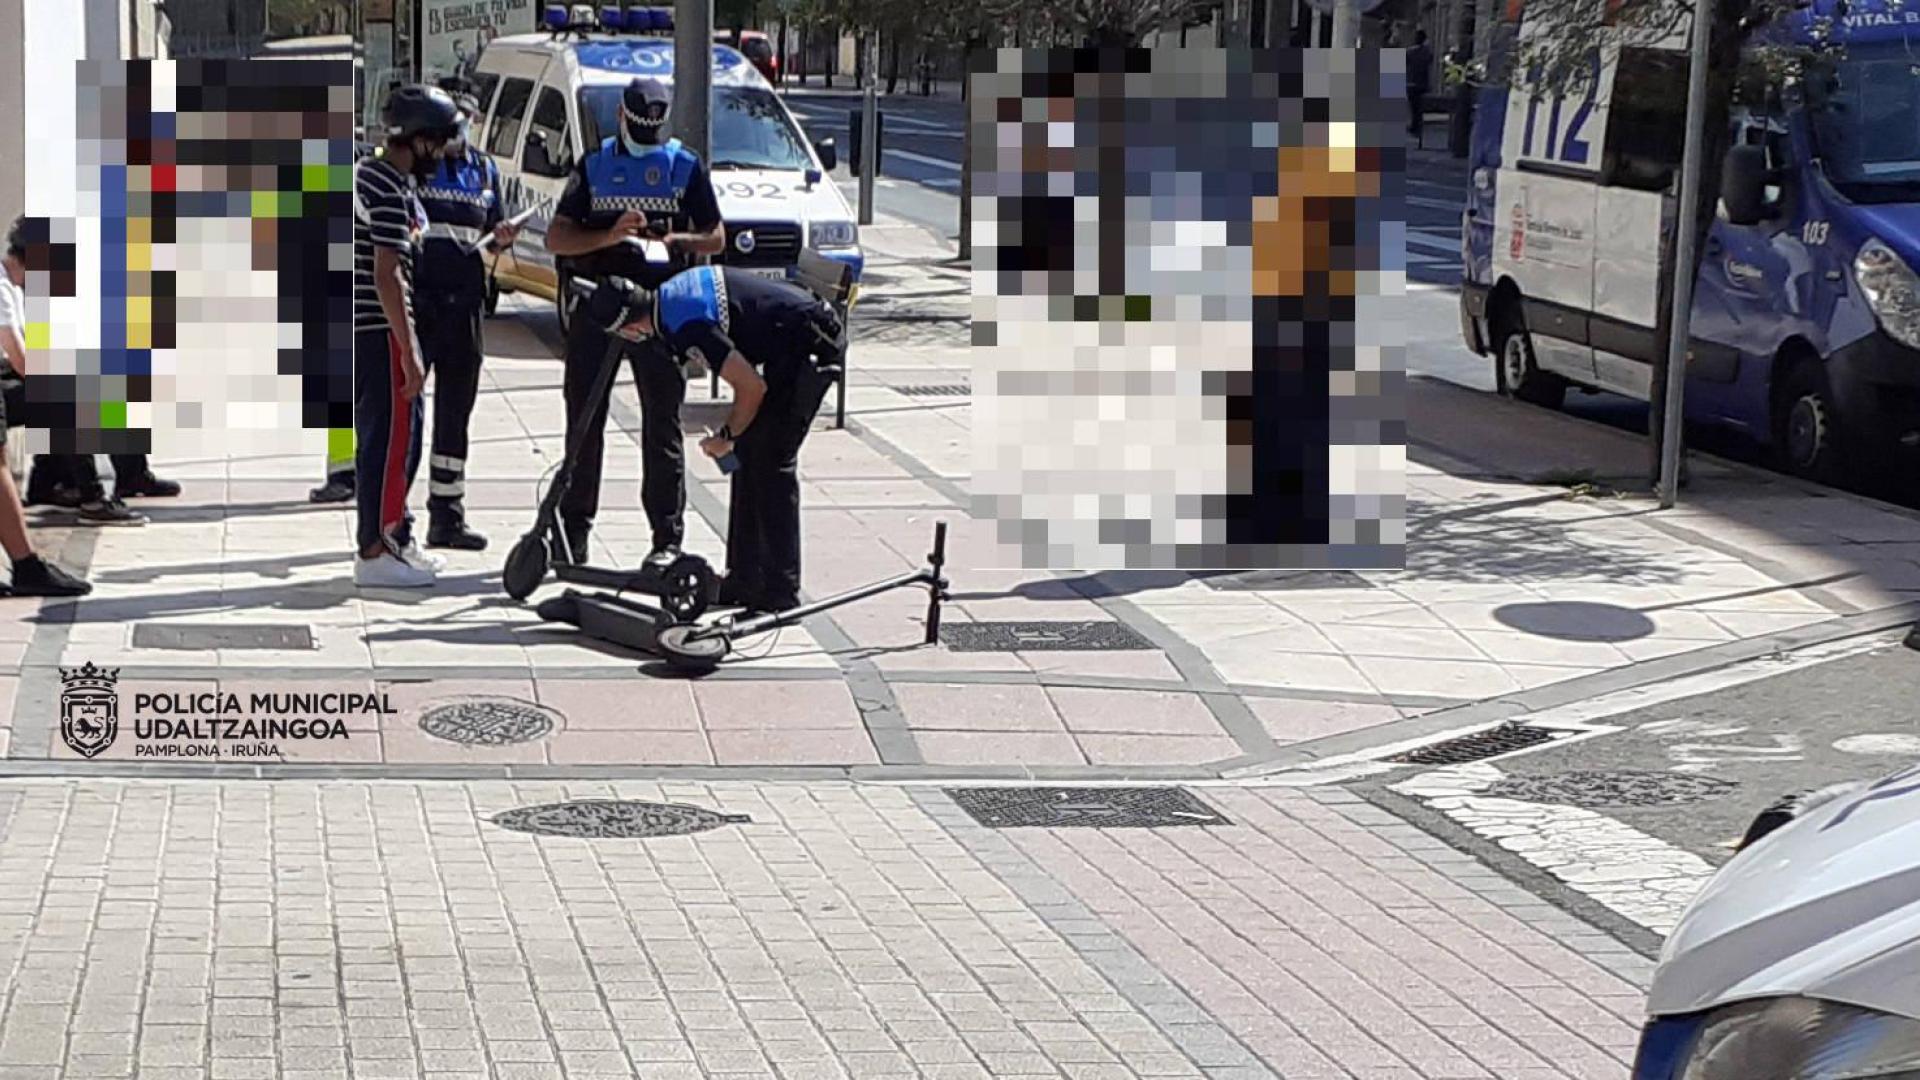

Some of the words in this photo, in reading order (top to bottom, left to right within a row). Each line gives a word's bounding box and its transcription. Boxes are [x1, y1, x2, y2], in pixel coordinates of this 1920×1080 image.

[1842, 13, 1901, 28] VITAL
[1521, 46, 1600, 165] 112
[1803, 219, 1830, 245] 103
